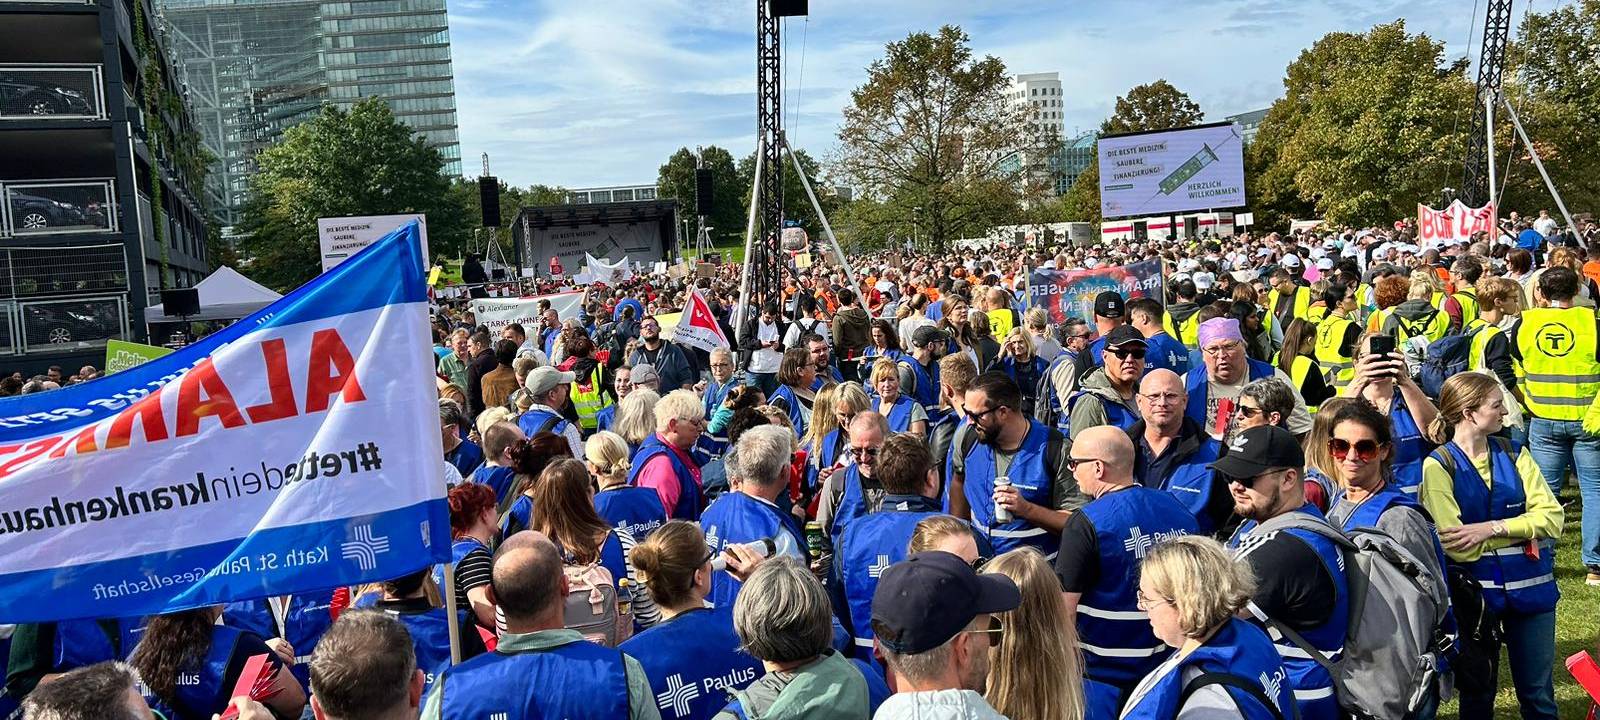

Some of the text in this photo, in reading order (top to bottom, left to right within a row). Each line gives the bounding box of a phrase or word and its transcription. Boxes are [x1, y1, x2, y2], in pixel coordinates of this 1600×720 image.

[1107, 150, 1117, 158] DIE
[1119, 148, 1137, 156] BESTE
[1116, 158, 1144, 167] SAUBERE
[1187, 180, 1222, 191] HERZLICH
[1188, 187, 1240, 199] WILLKOMMEN!
[487, 303, 519, 313] Alexianer
[634, 519, 661, 533] Paulus
[703, 666, 756, 694] Paulus
